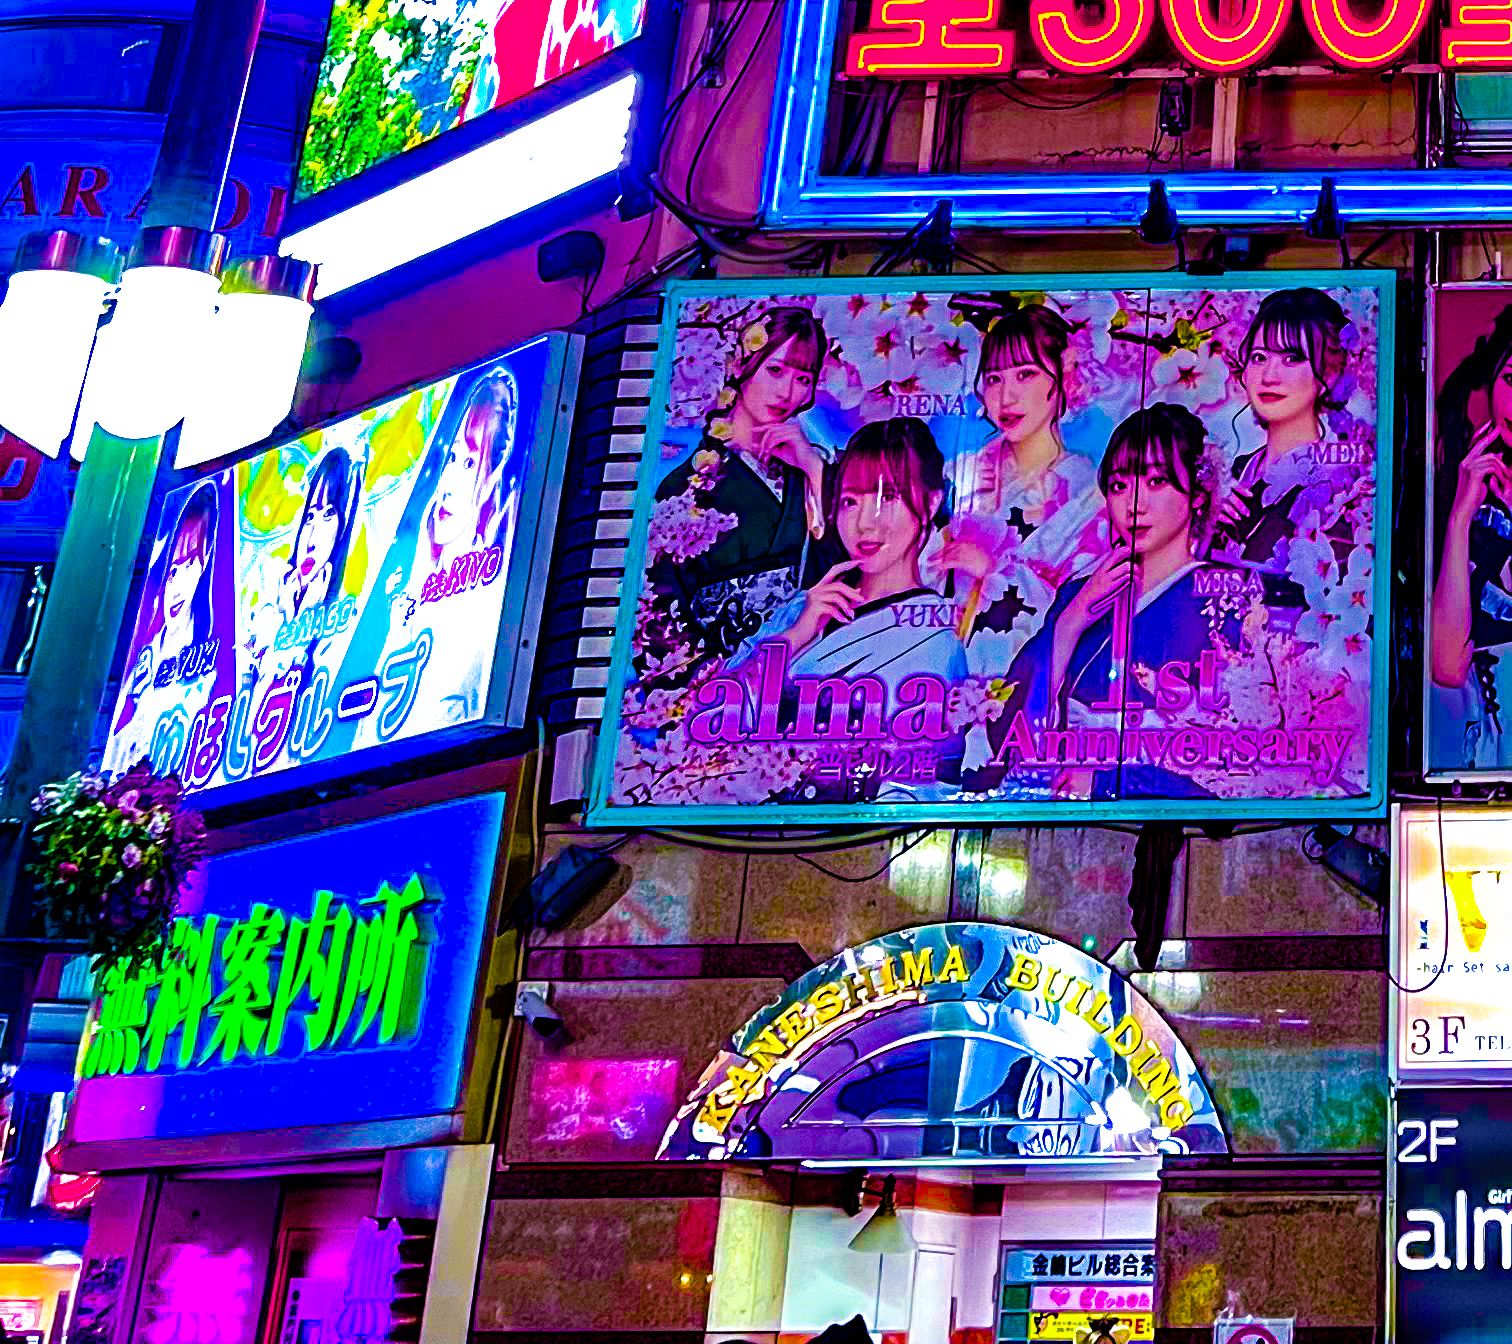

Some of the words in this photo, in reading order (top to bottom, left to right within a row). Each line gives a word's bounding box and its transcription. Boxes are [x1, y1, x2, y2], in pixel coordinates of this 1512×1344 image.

[896, 393, 966, 417] RENA
[891, 603, 960, 628] YUKI
[1088, 580, 1230, 710] 1st
[687, 641, 953, 746] alma
[989, 710, 1354, 787] Anniversary
[82, 873, 424, 1079] 無料案内所
[698, 944, 969, 1134] KANESHIMA
[1006, 951, 1195, 1131] BUILDING
[1411, 1016, 1465, 1055] 3F
[1398, 1119, 1459, 1163] 2F
